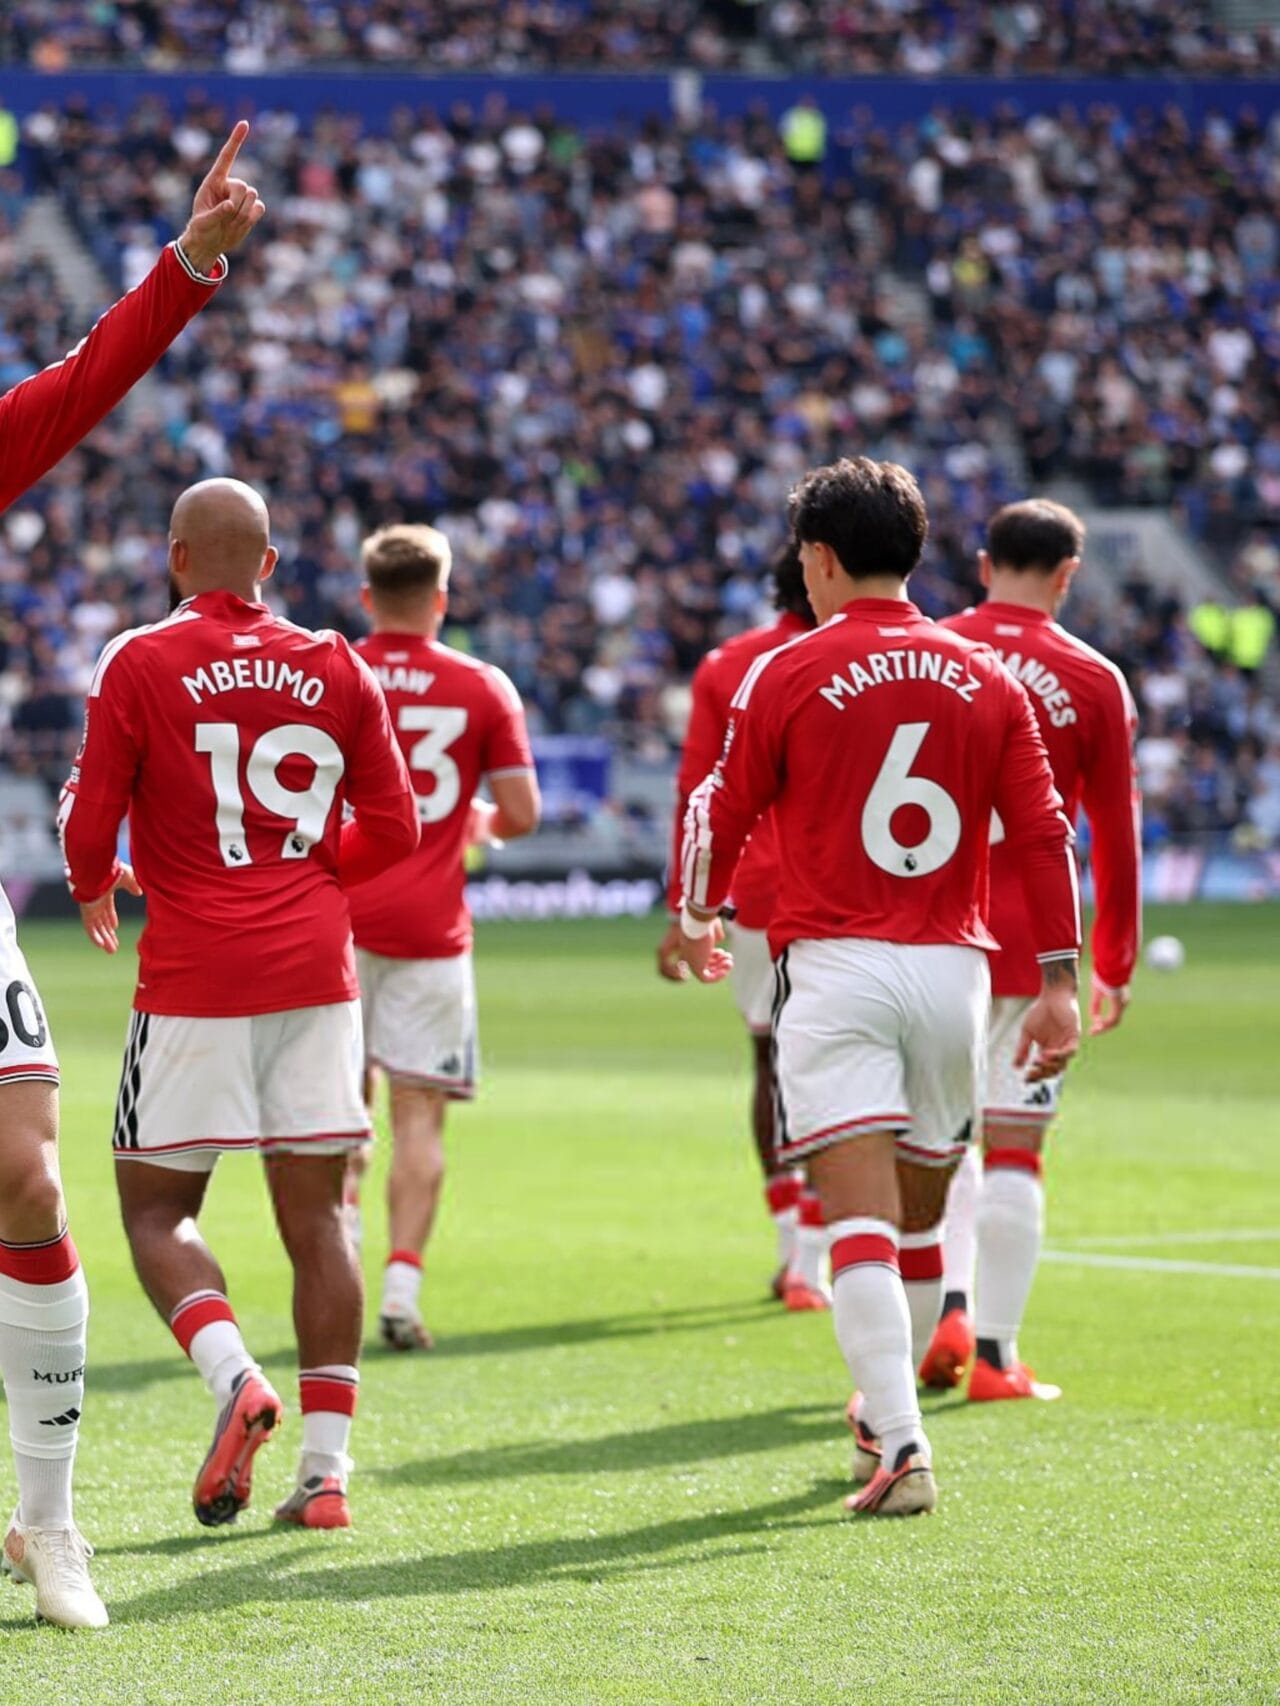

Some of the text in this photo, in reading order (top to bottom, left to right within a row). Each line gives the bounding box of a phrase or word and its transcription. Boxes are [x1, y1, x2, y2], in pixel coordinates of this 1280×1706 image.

[181, 658, 325, 707] MBEUMO
[372, 665, 436, 696] HAW
[819, 650, 982, 711] MARTINEZ
[993, 649, 1078, 728] ANDES
[195, 722, 345, 868] 19
[861, 721, 962, 878] 6
[31, 1365, 85, 1385] MUF
